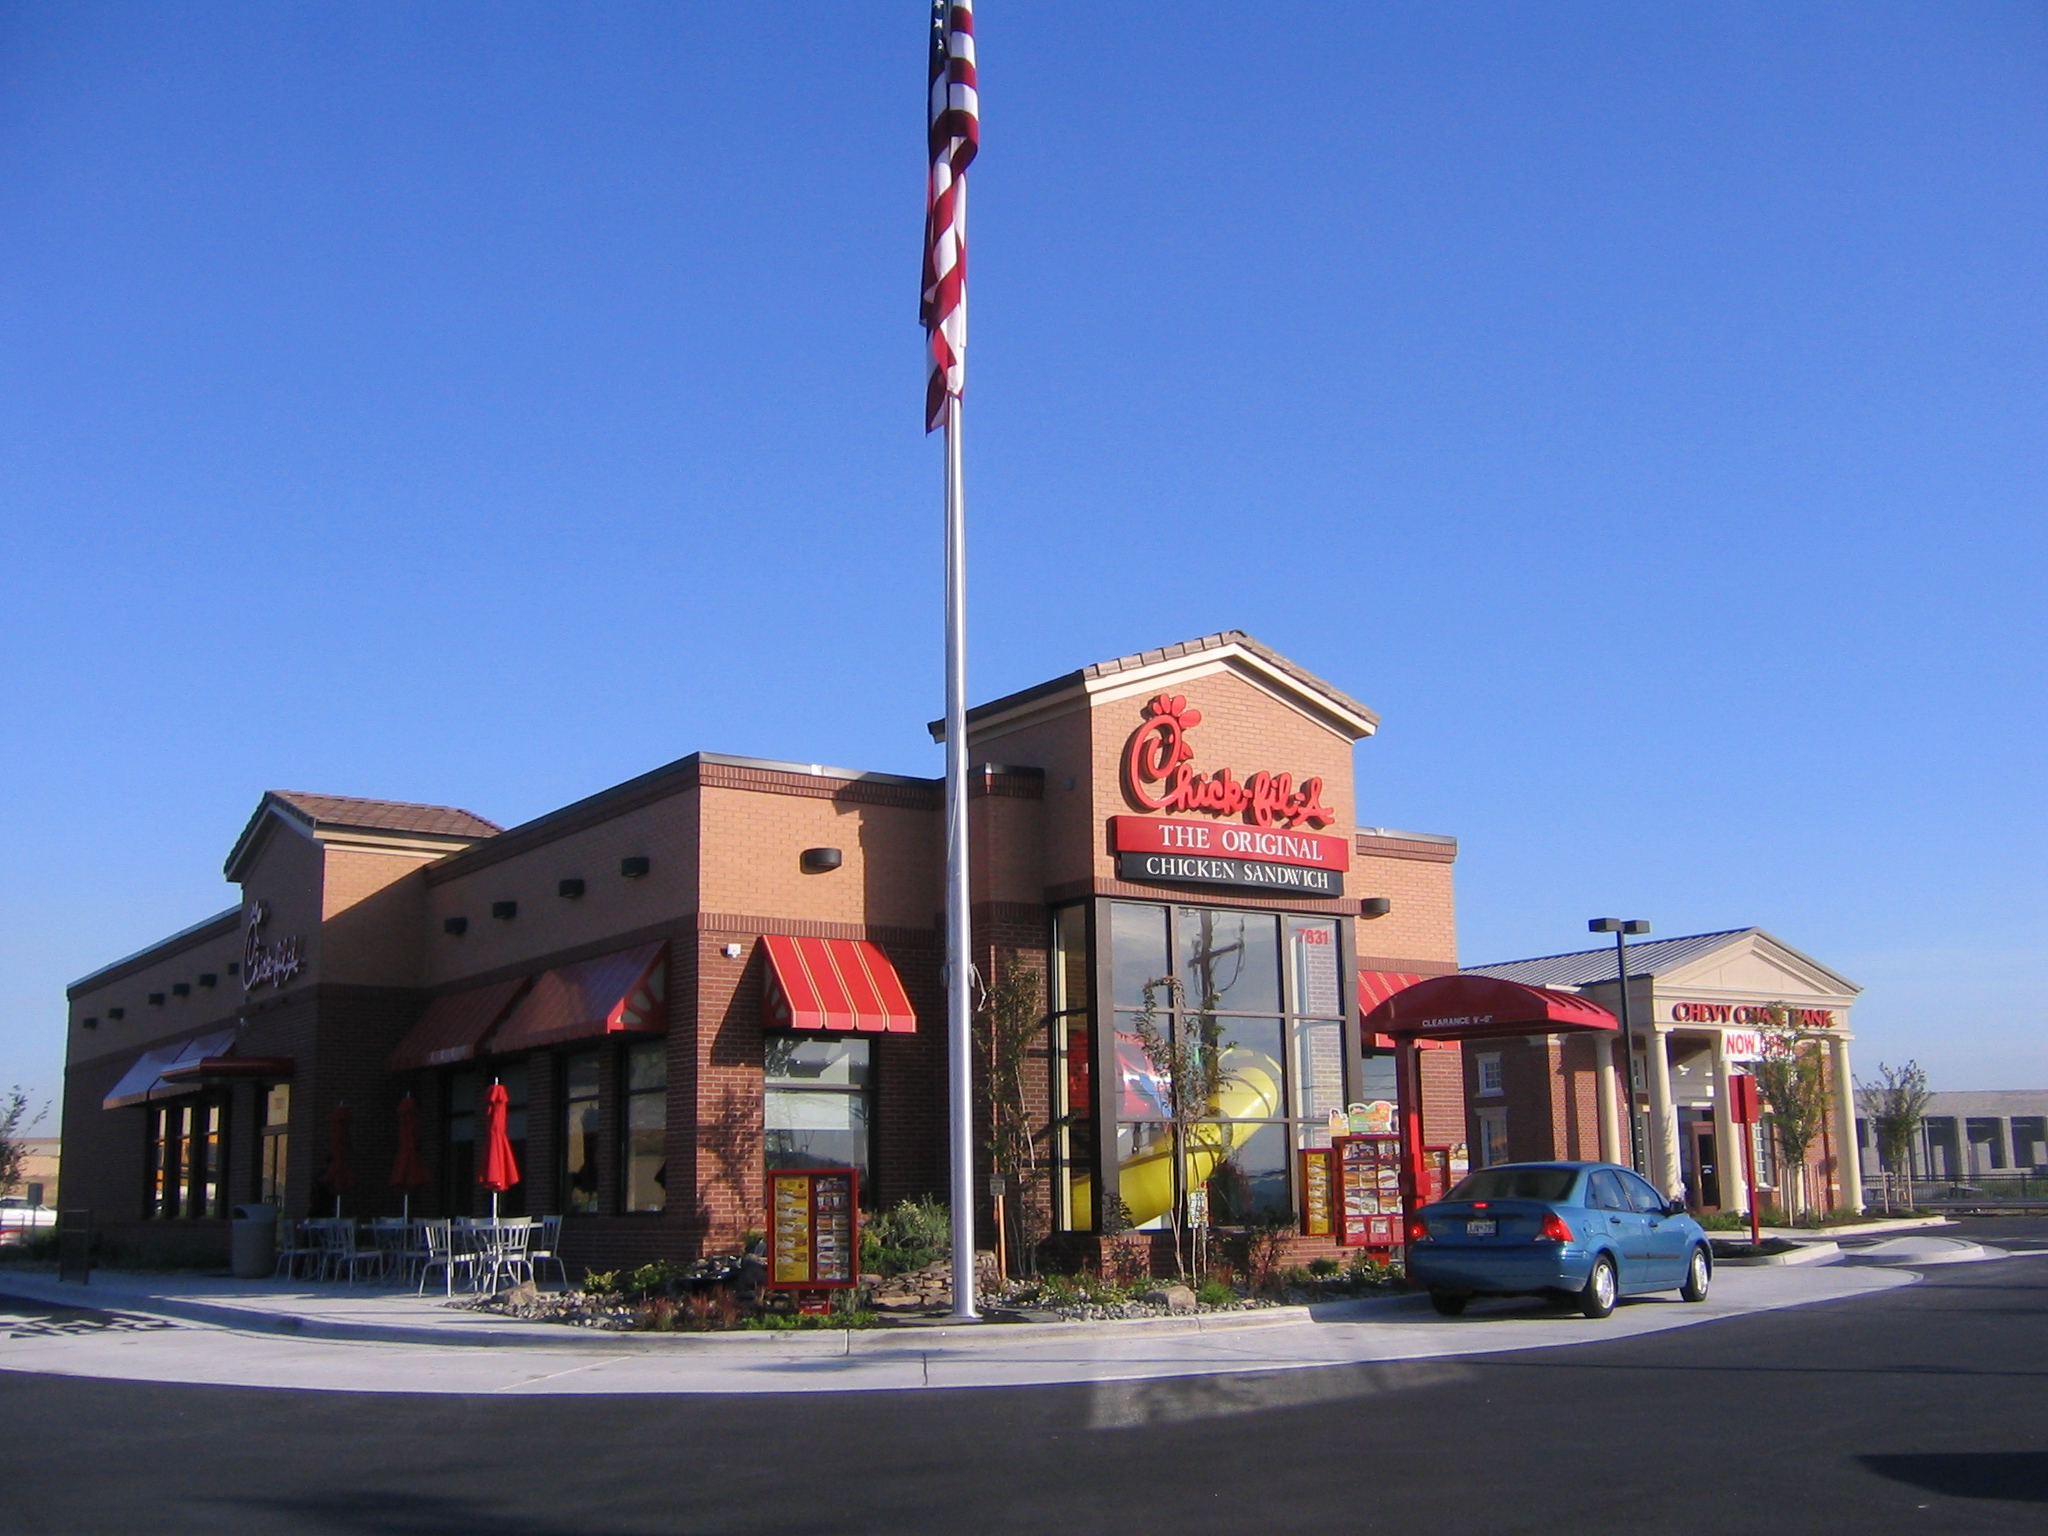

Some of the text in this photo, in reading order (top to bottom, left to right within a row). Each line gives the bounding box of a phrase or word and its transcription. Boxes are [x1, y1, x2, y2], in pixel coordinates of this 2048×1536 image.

[1129, 693, 1336, 828] Chick-fil-A
[1158, 824, 1323, 861] THE ORIGINAL
[1146, 856, 1329, 889] CHICKEN SANDWICH
[1296, 927, 1329, 945] 7831
[1422, 1016, 1470, 1028] CLEARANCE
[1674, 1002, 1733, 1023] CHEVY
[1734, 1005, 1788, 1026] CHAE
[1726, 1034, 1755, 1055] NOW
